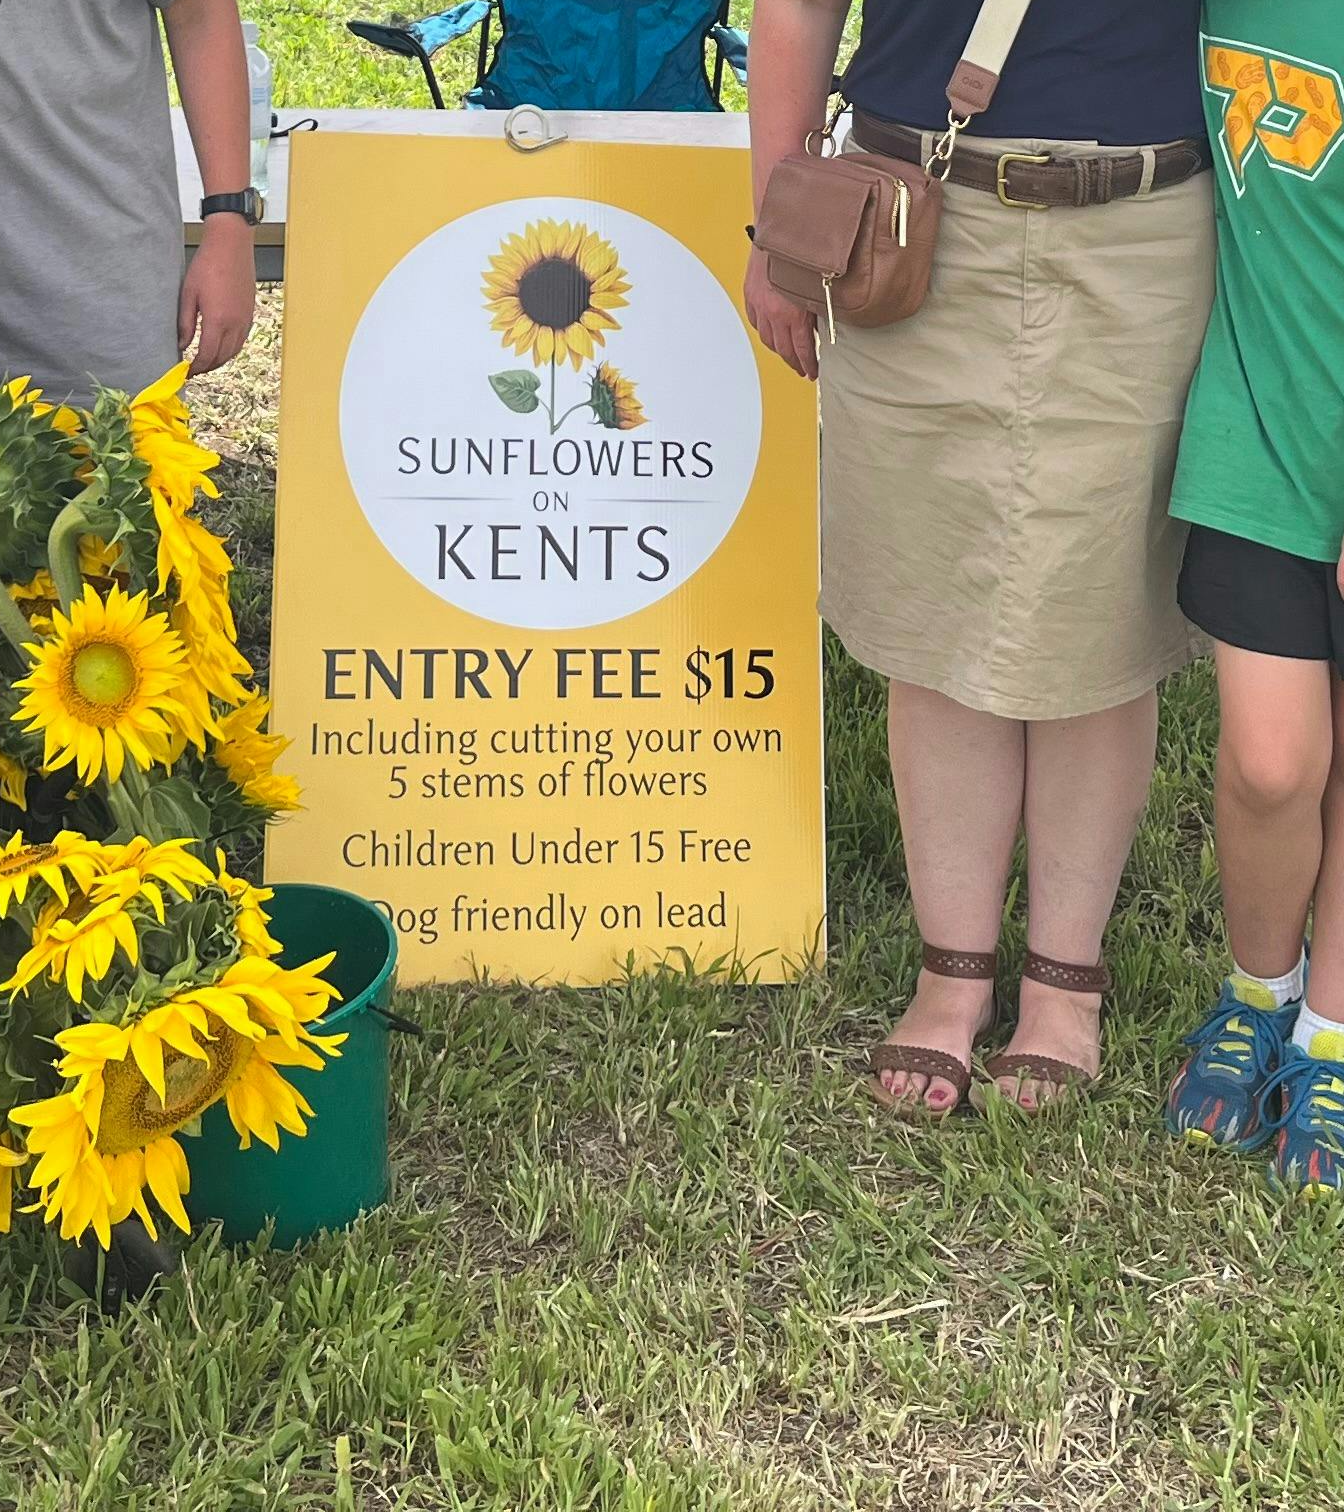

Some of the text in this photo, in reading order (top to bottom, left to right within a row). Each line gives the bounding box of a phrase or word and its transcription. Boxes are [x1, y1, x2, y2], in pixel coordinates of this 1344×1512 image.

[397, 436, 715, 478] SUNFLOWERS
[532, 490, 569, 512] ON
[434, 524, 671, 582] KENTS
[322, 644, 776, 705] ENTRY FEE $15
[311, 718, 783, 765] Including cutting your own
[388, 758, 708, 800] 5 stems of flowers
[343, 827, 752, 868] Children Under 15 Free
[450, 893, 587, 941] friendly
[600, 903, 642, 929] on
[655, 891, 727, 928] lead
